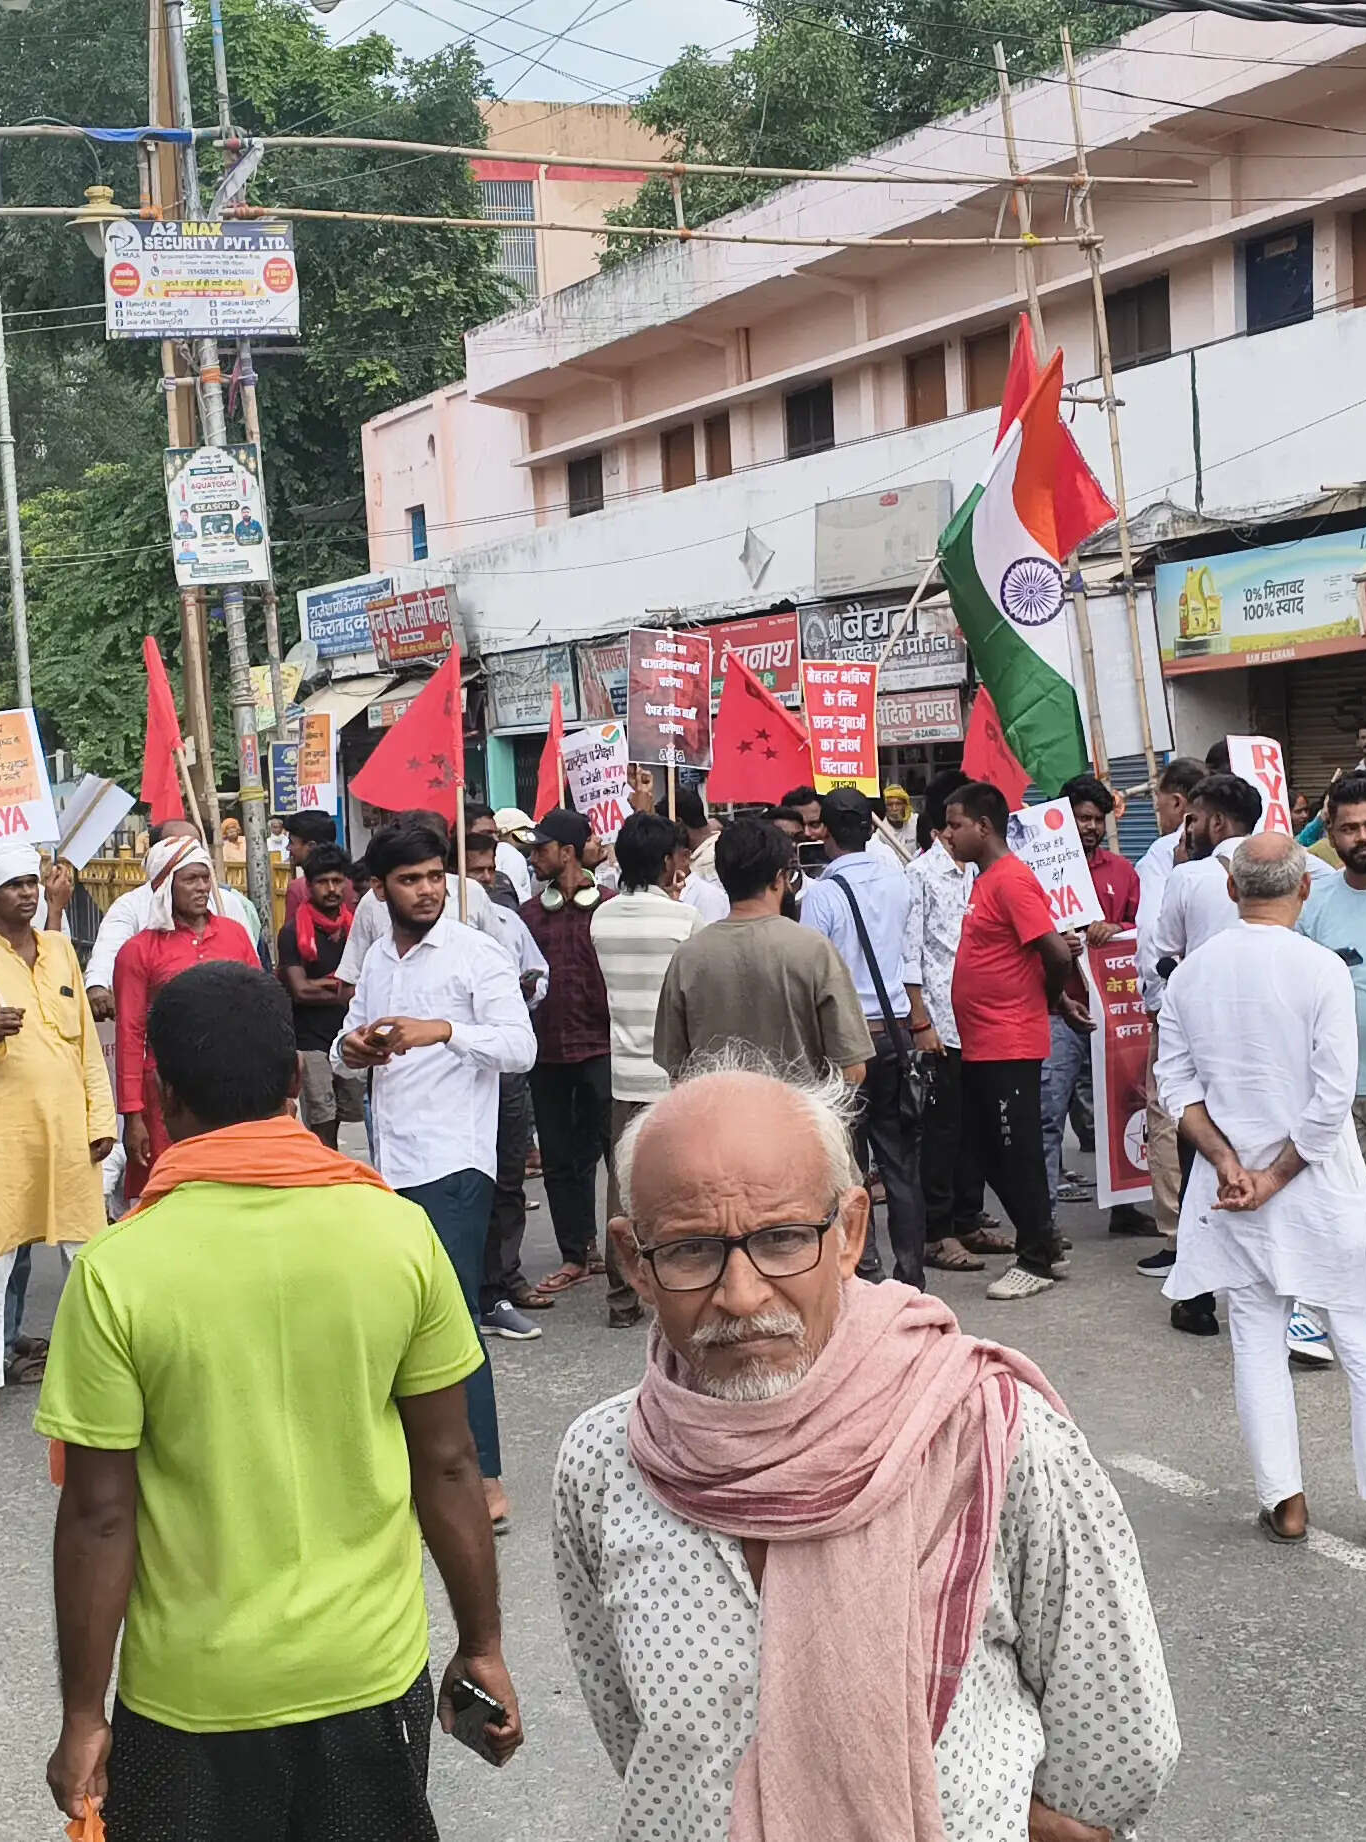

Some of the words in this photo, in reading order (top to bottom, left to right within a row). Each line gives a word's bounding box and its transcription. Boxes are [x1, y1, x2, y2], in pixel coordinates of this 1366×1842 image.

[150, 221, 177, 236] A2
[182, 222, 223, 236] MAX
[144, 236, 220, 250] SECURITY
[224, 236, 256, 250] PVT.
[258, 235, 290, 250] LTD.
[195, 502, 229, 512] SEASON
[1263, 579, 1305, 600] मिलावट
[1243, 602, 1274, 621] 100%
[1275, 597, 1305, 616] स्वाद
[345, 615, 370, 638] दुक
[841, 602, 915, 640] बैद्यन
[686, 661, 702, 675] नहीं
[806, 666, 838, 684] बेहतर
[840, 667, 871, 685] भविष्य
[822, 689, 836, 707] के
[837, 689, 859, 708] लिए
[682, 706, 698, 721] नहीं
[819, 737, 834, 752] का
[604, 765, 626, 779] NTA
[1250, 743, 1289, 834] RYA
[587, 799, 627, 836] RYA
[1104, 954, 1136, 971] पटन
[1106, 976, 1123, 992] के
[1108, 1002, 1128, 1015] जा
